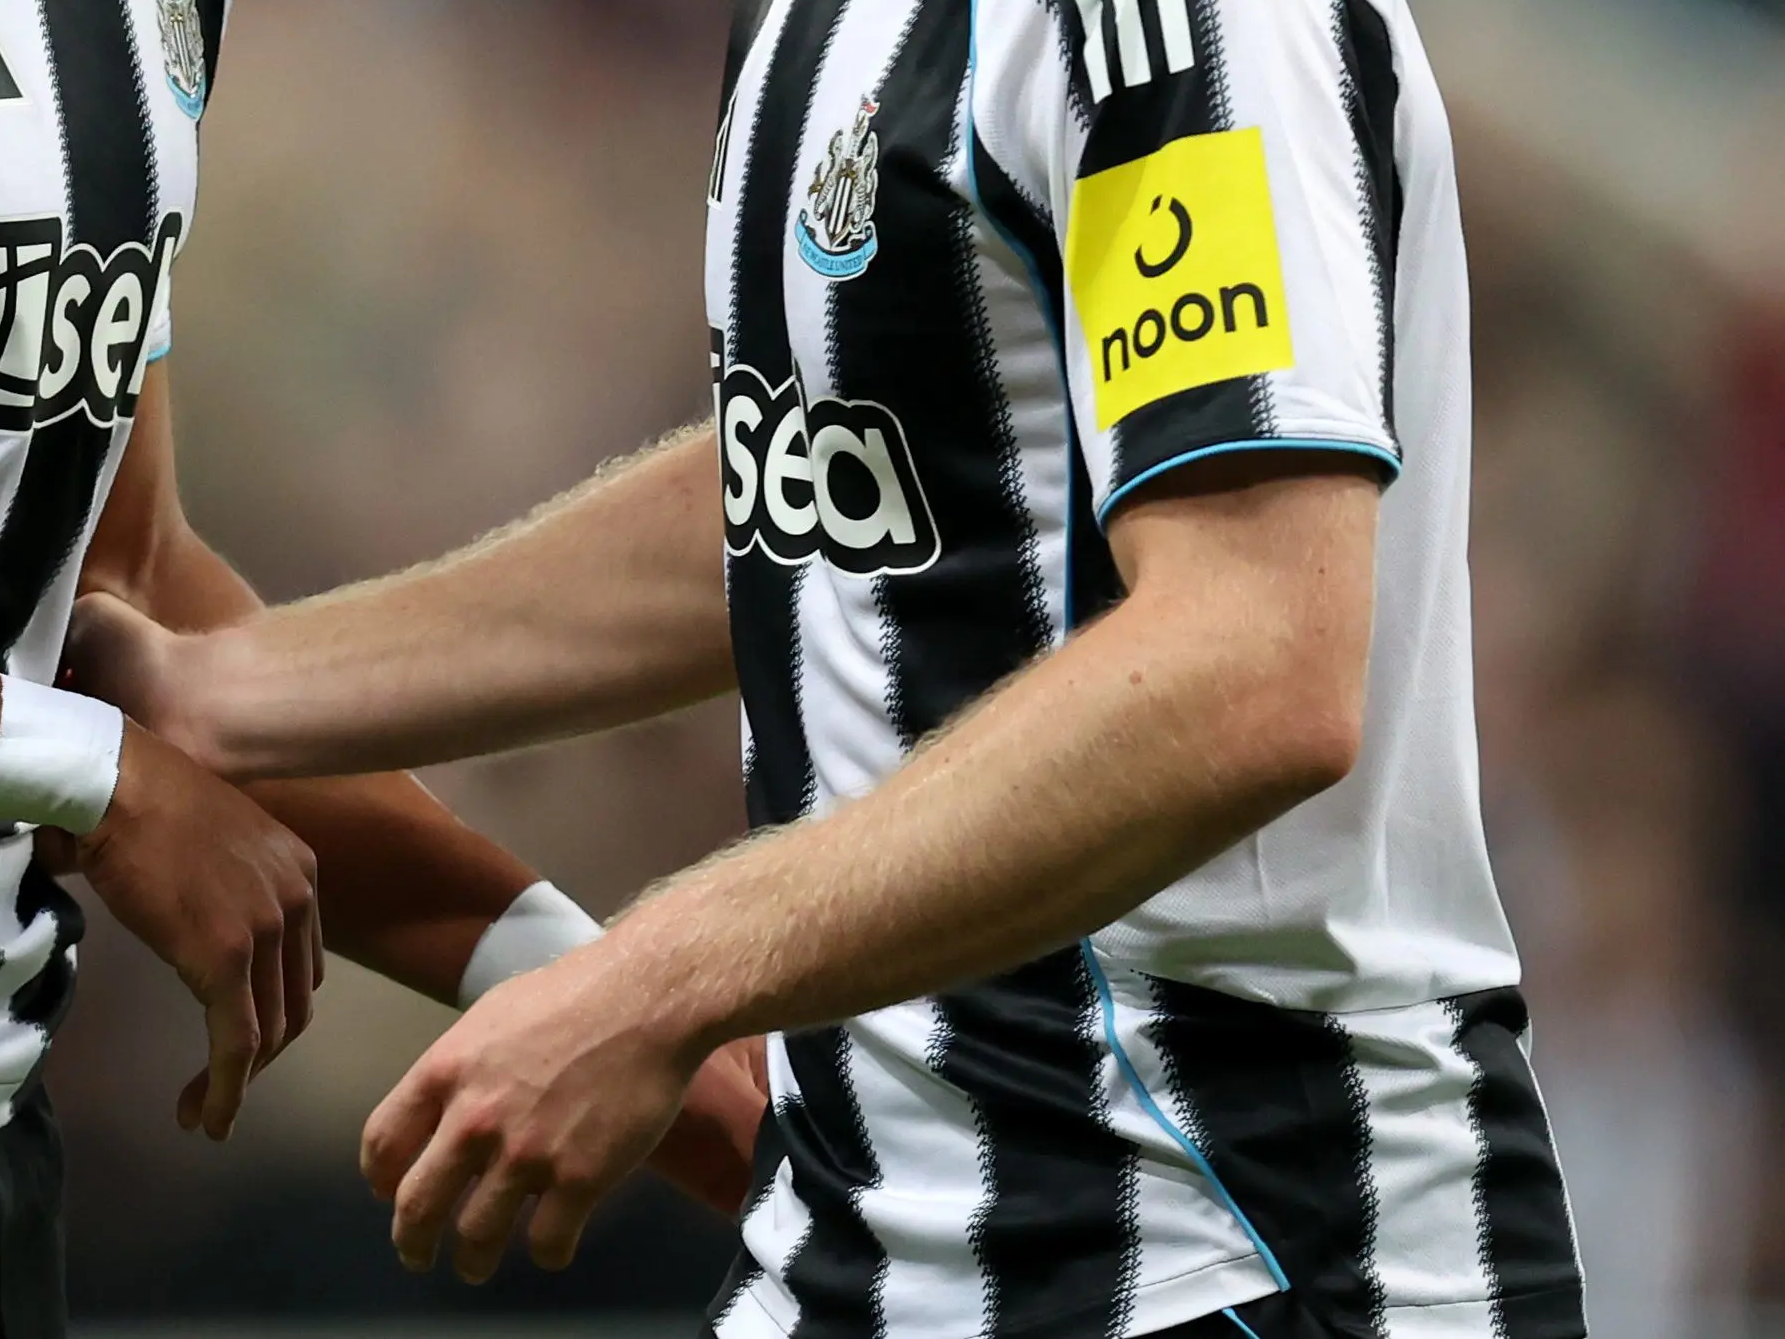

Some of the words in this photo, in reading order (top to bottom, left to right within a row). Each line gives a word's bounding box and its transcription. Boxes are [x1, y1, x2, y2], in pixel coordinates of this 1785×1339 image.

[39, 236, 175, 400] sel
[1102, 282, 1269, 382] noon
[724, 395, 917, 550] sea
